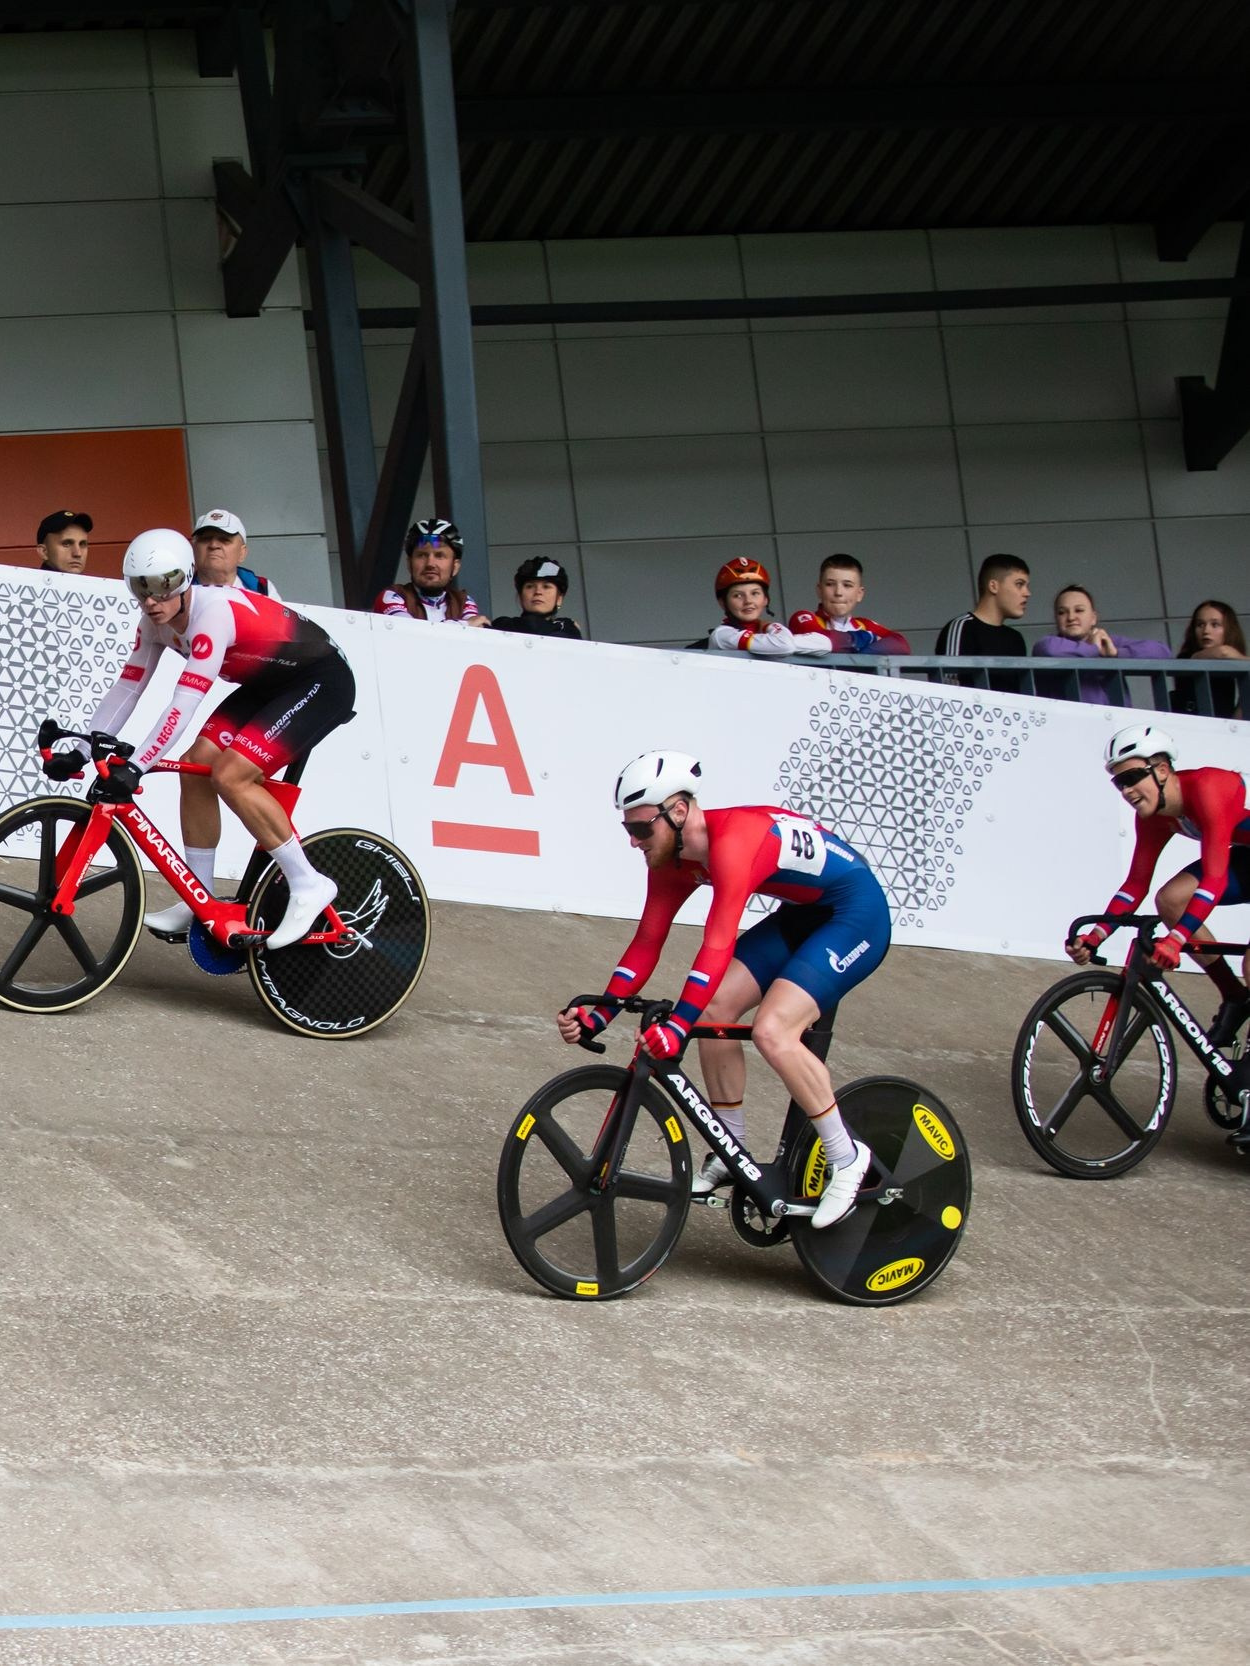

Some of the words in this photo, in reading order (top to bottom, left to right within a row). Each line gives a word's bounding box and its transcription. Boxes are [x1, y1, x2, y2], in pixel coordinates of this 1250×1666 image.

[181, 674, 209, 690] EMME
[139, 745, 161, 765] TULA
[156, 707, 182, 746] REGION
[234, 734, 274, 763] BIEMME
[128, 808, 209, 905] PINARELLO
[791, 829, 815, 860] 48
[75, 853, 94, 888] PINARELLO
[1151, 981, 1214, 1055] ARGON
[1210, 1053, 1233, 1077] 18
[667, 1074, 741, 1157] ARGON
[737, 1154, 762, 1182] 18
[919, 1113, 949, 1151] MAVIC
[877, 1262, 915, 1286] MAVIC
